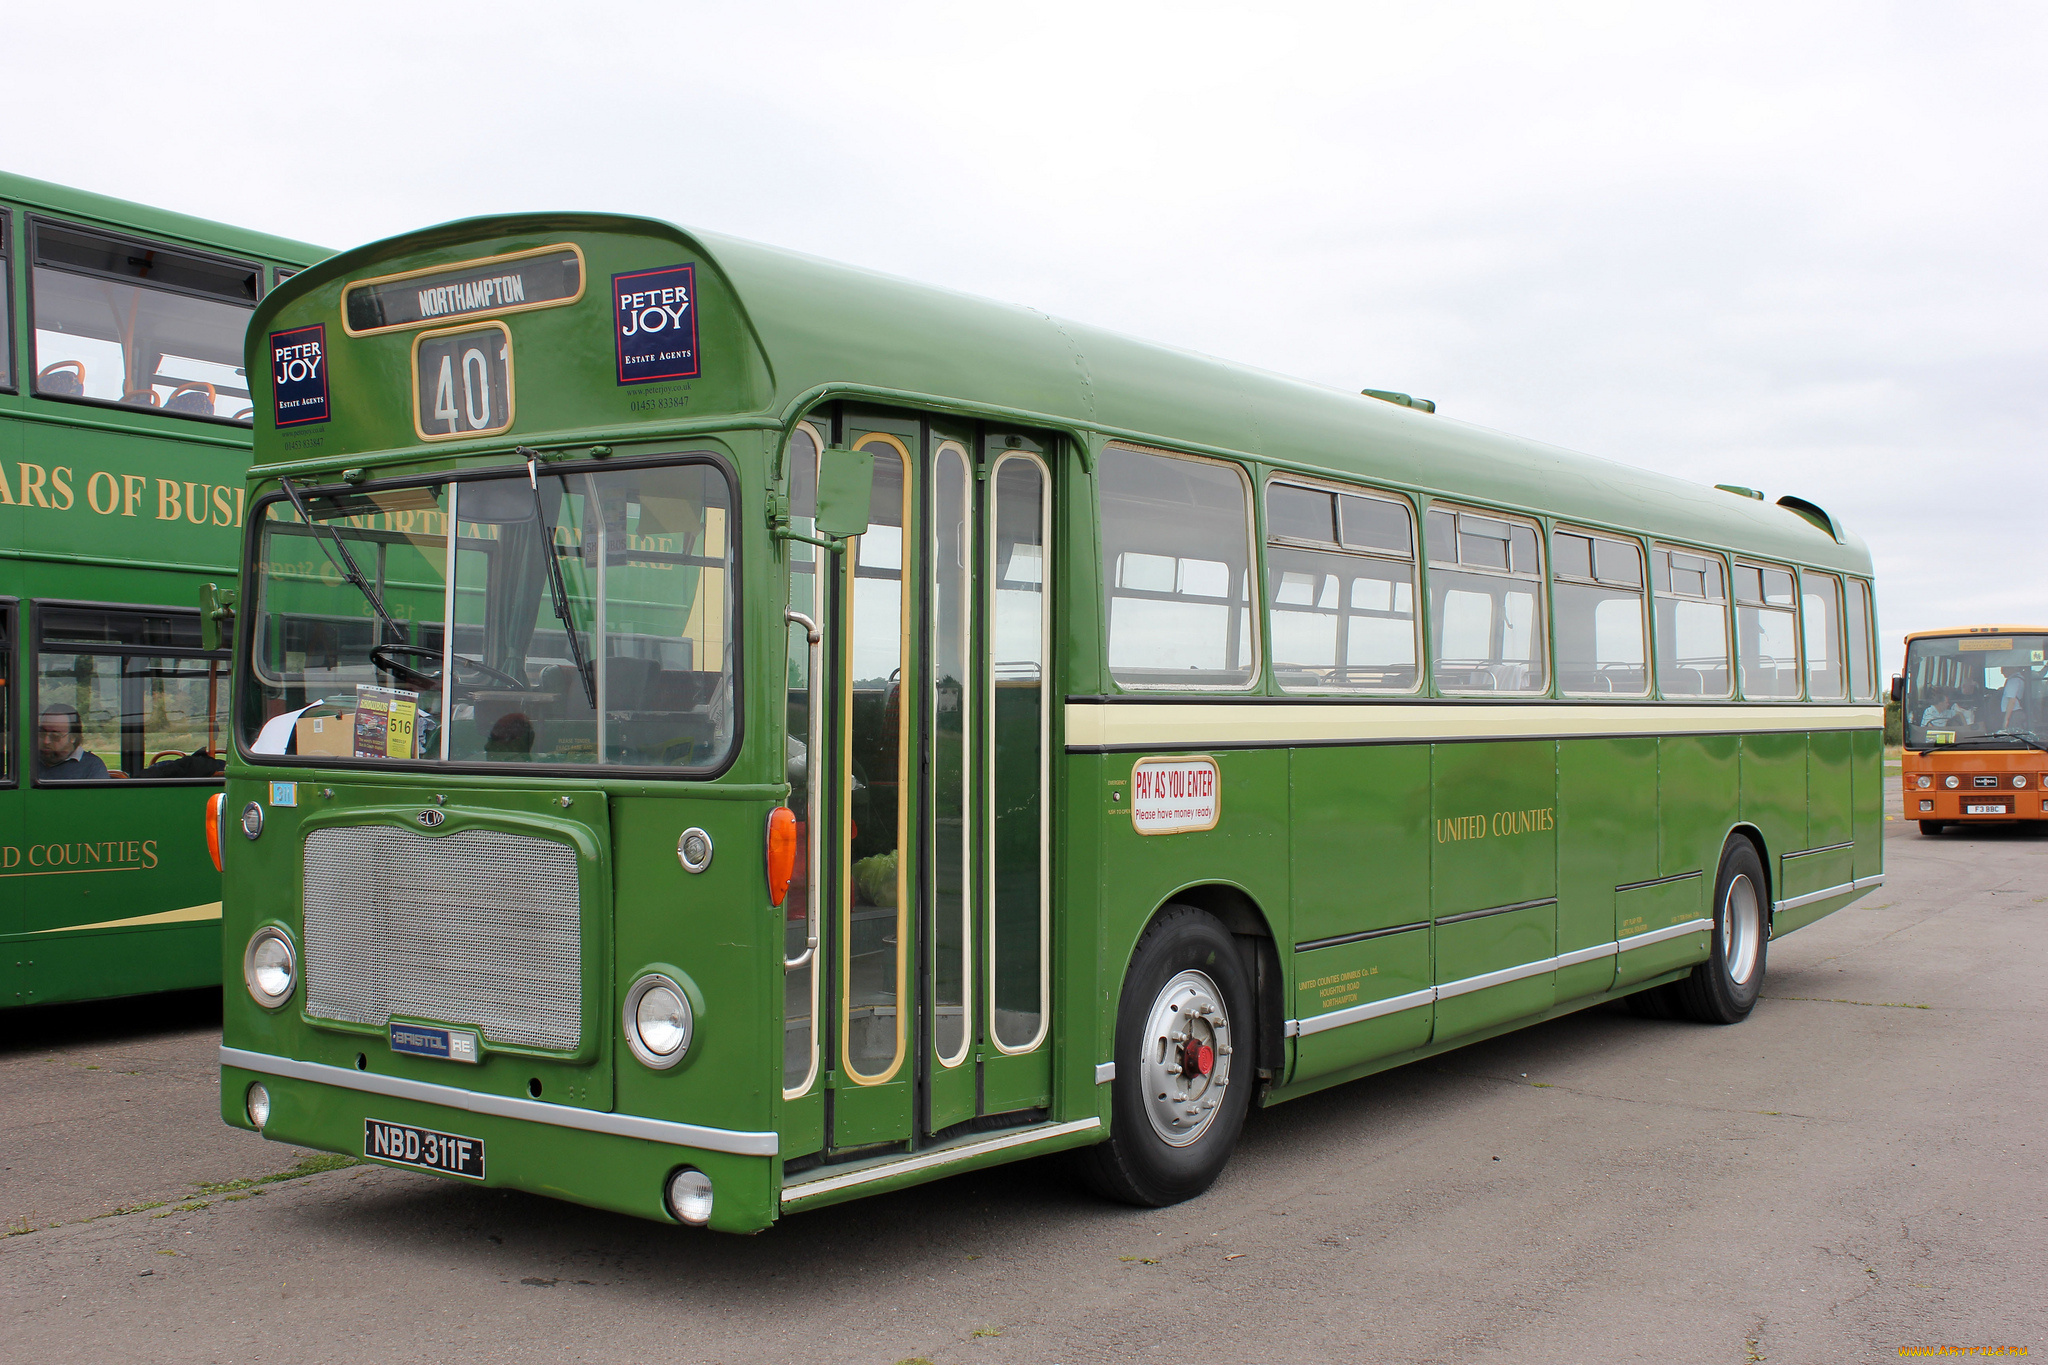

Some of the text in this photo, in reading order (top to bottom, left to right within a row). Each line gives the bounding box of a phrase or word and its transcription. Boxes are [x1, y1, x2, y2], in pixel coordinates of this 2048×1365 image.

[418, 274, 525, 317] NORTHAMPTON
[620, 286, 689, 310] PETER
[622, 302, 689, 336] JOY
[275, 342, 321, 362] PETER
[277, 356, 322, 385] JOY
[627, 382, 692, 397] www.peterjoy.co.uk
[630, 396, 689, 412] 01453 833847
[87, 471, 146, 517] OF
[390, 718, 411, 734] 516
[1136, 770, 1213, 799] PAY AS YOU ENTER
[1136, 806, 1213, 820] Please have money ready
[1437, 807, 1554, 843] UNITED COUNTIES
[0, 840, 158, 869] D COUNTIES
[1298, 979, 1316, 991] UNITED
[1317, 974, 1340, 987] COUNTIES
[1340, 969, 1361, 982] OMNIBUS
[1320, 981, 1360, 998] HOUGHTON ROAD
[1322, 993, 1358, 1008] NORTHAMPTON
[395, 1031, 471, 1053] BRISTOL RE
[374, 1124, 472, 1170] NBD 311F
